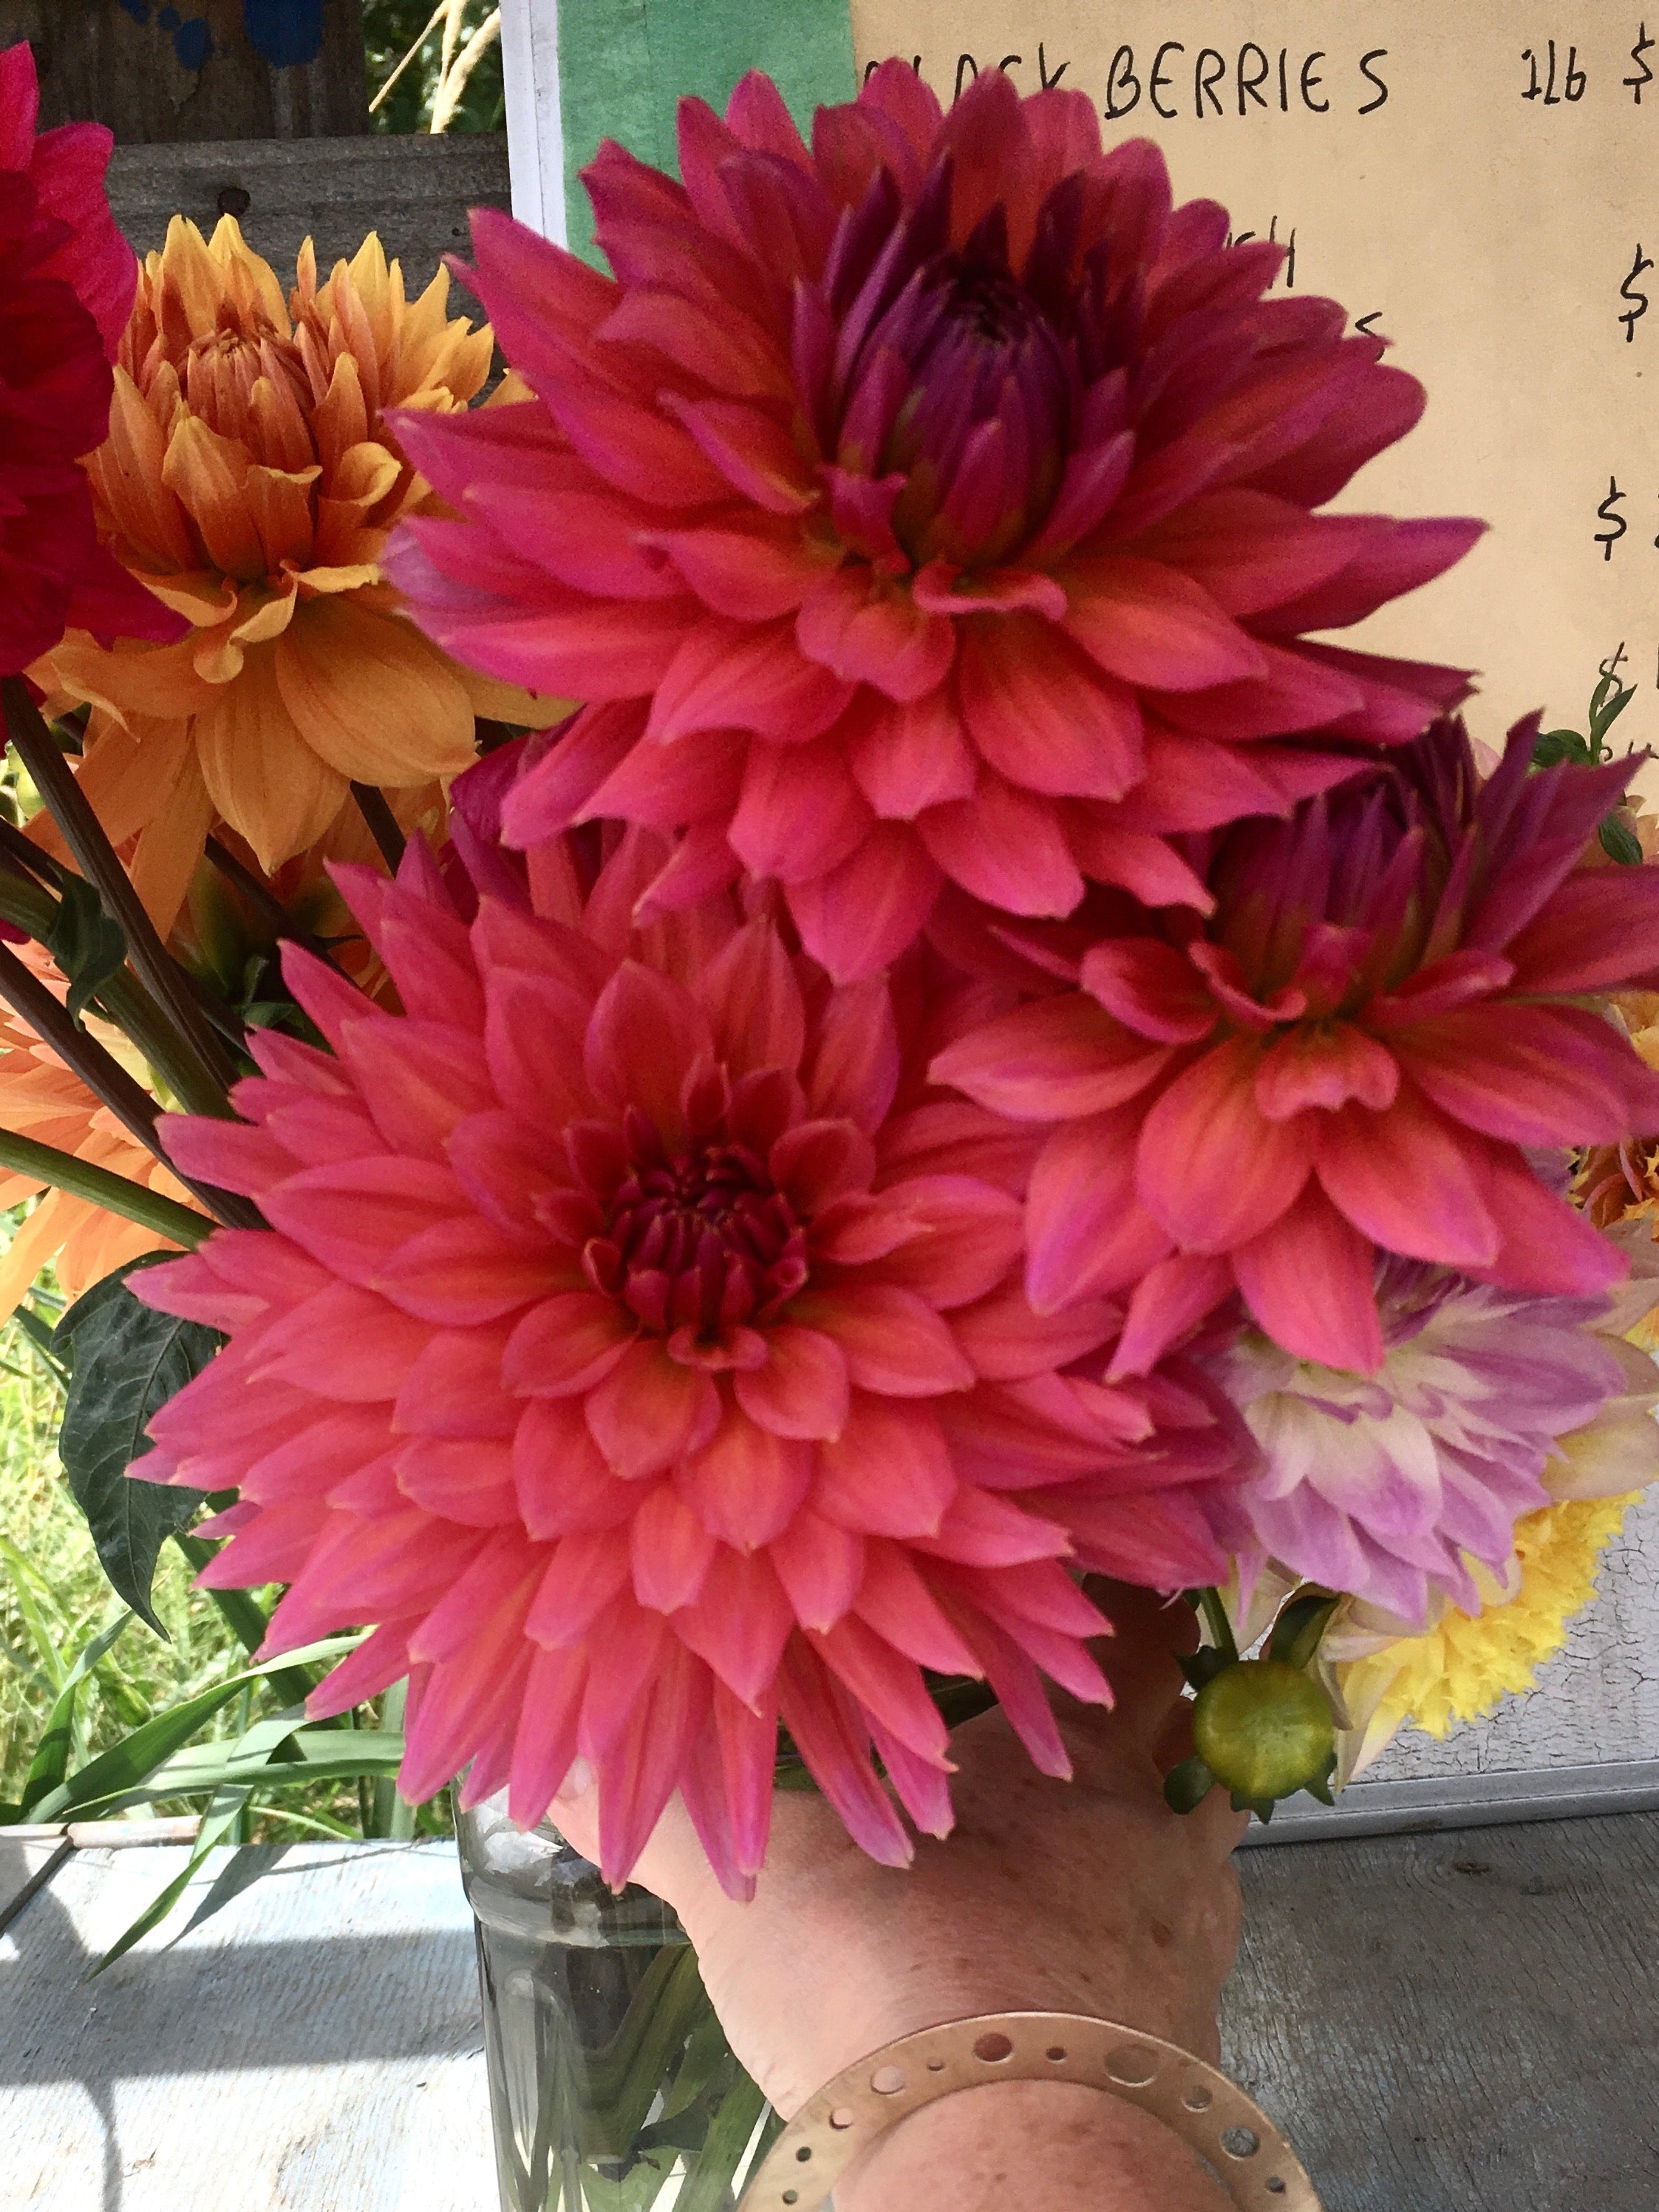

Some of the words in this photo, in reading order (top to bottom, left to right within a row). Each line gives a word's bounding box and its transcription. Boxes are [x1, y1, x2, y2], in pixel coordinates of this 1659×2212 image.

[1104, 41, 1388, 120] BERRIES
[1623, 21, 1655, 104] $
[1618, 243, 1655, 342] $
